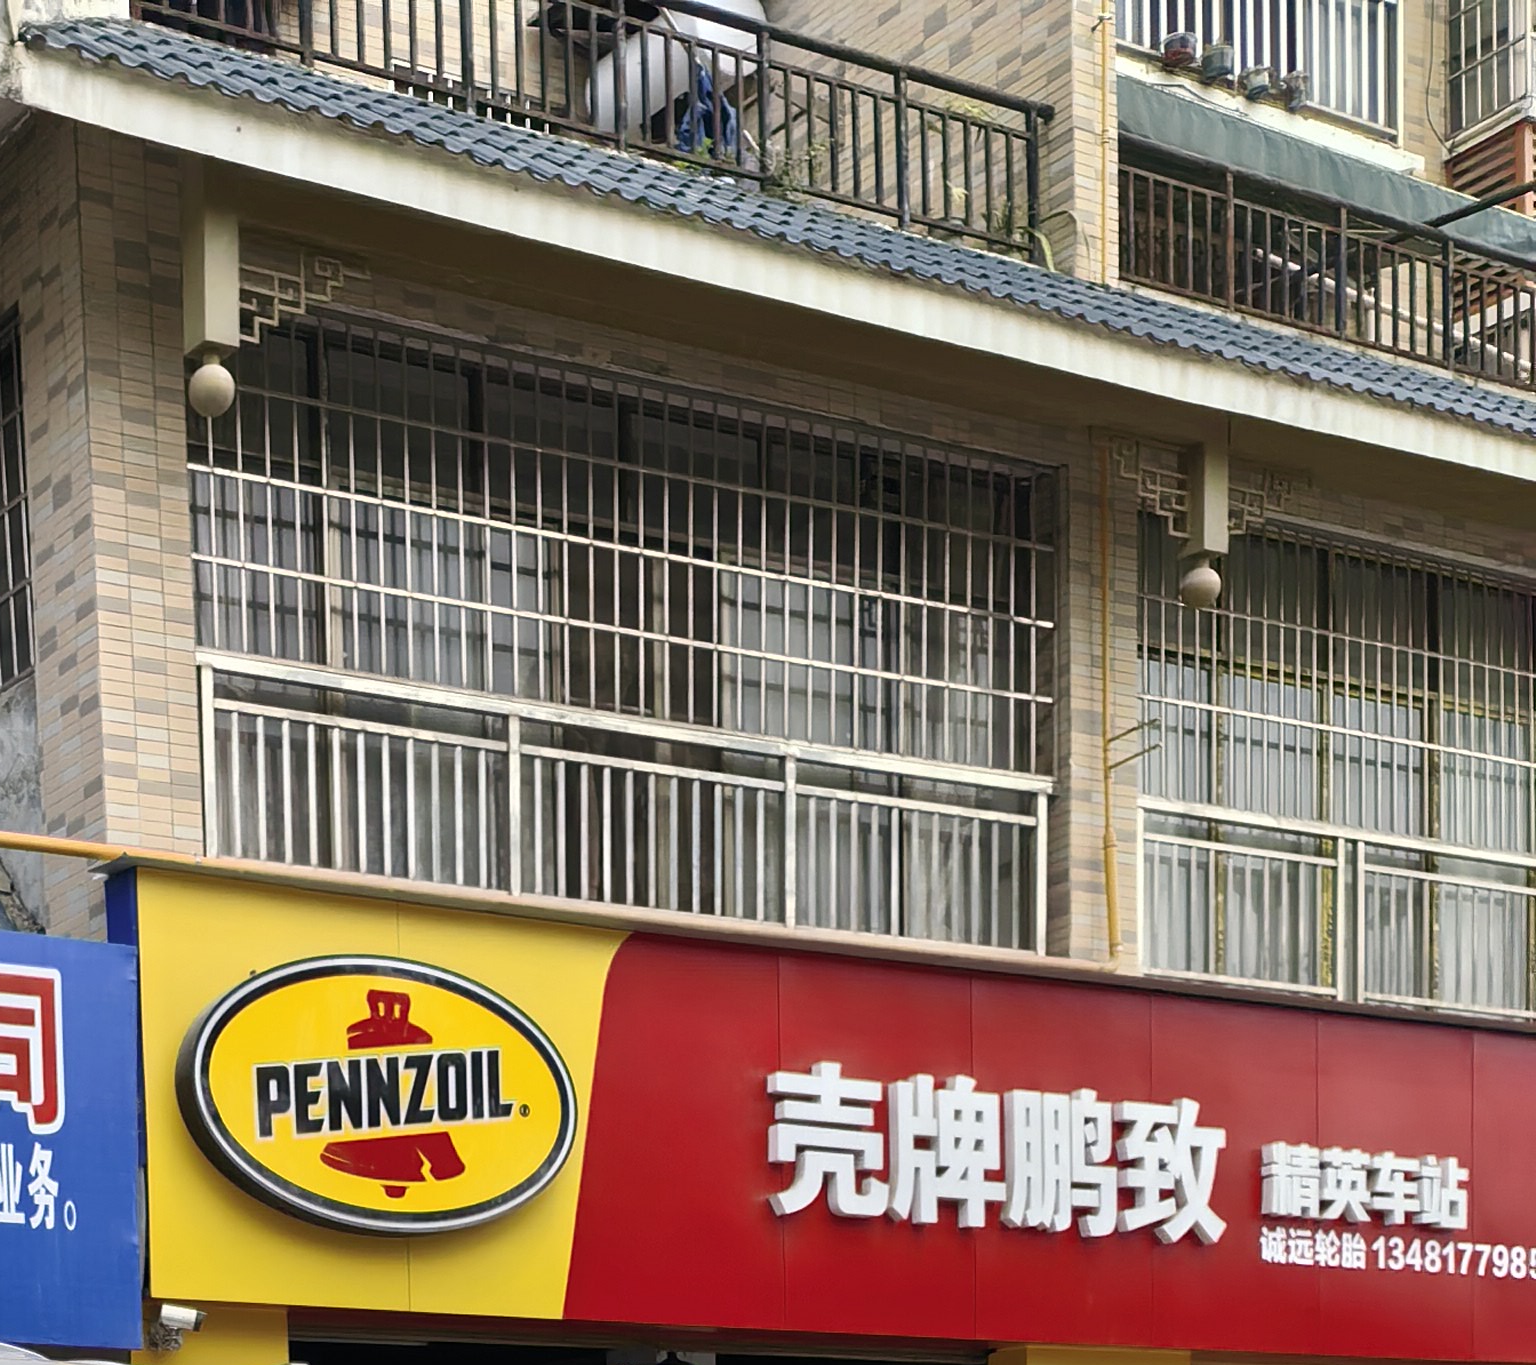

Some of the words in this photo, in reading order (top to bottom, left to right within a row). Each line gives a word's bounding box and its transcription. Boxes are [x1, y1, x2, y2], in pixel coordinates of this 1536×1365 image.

[254, 1047, 514, 1140] PENNZOIL
[766, 1060, 1228, 1246] 壳牌鹏致
[1260, 1140, 1470, 1230] 精英车站
[1259, 1226, 1368, 1271] 诚远轮胎
